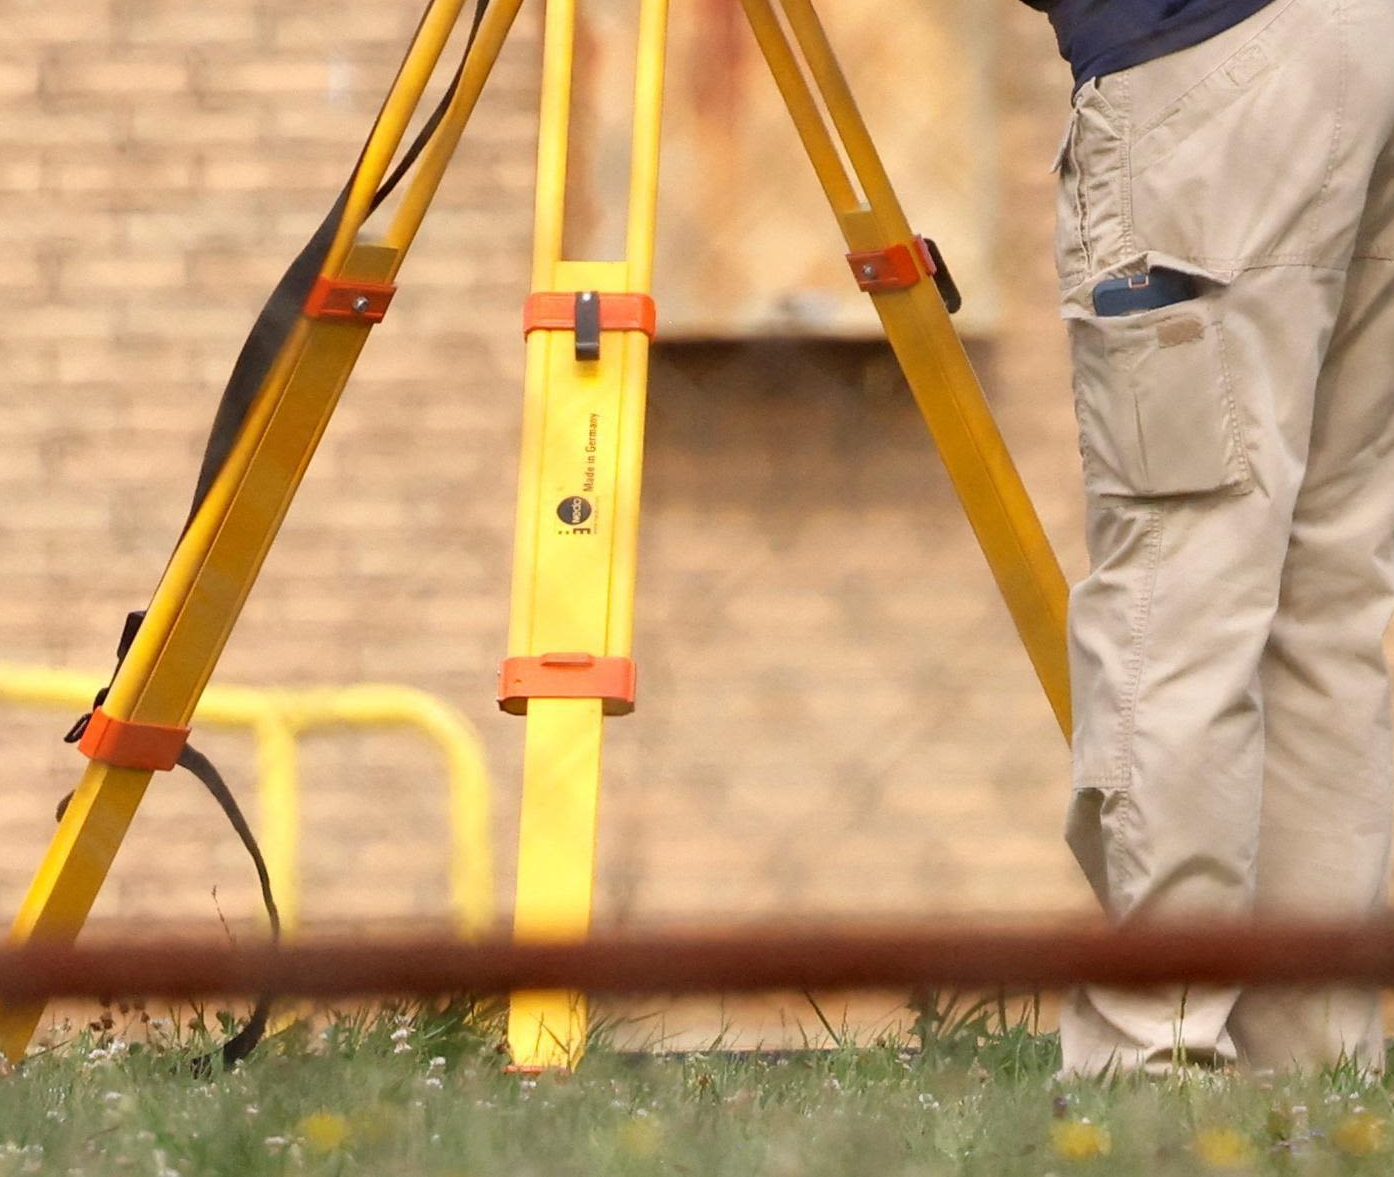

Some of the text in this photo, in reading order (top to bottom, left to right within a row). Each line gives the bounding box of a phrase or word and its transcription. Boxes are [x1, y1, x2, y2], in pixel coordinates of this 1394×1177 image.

[583, 413, 599, 492] Made in Germany
